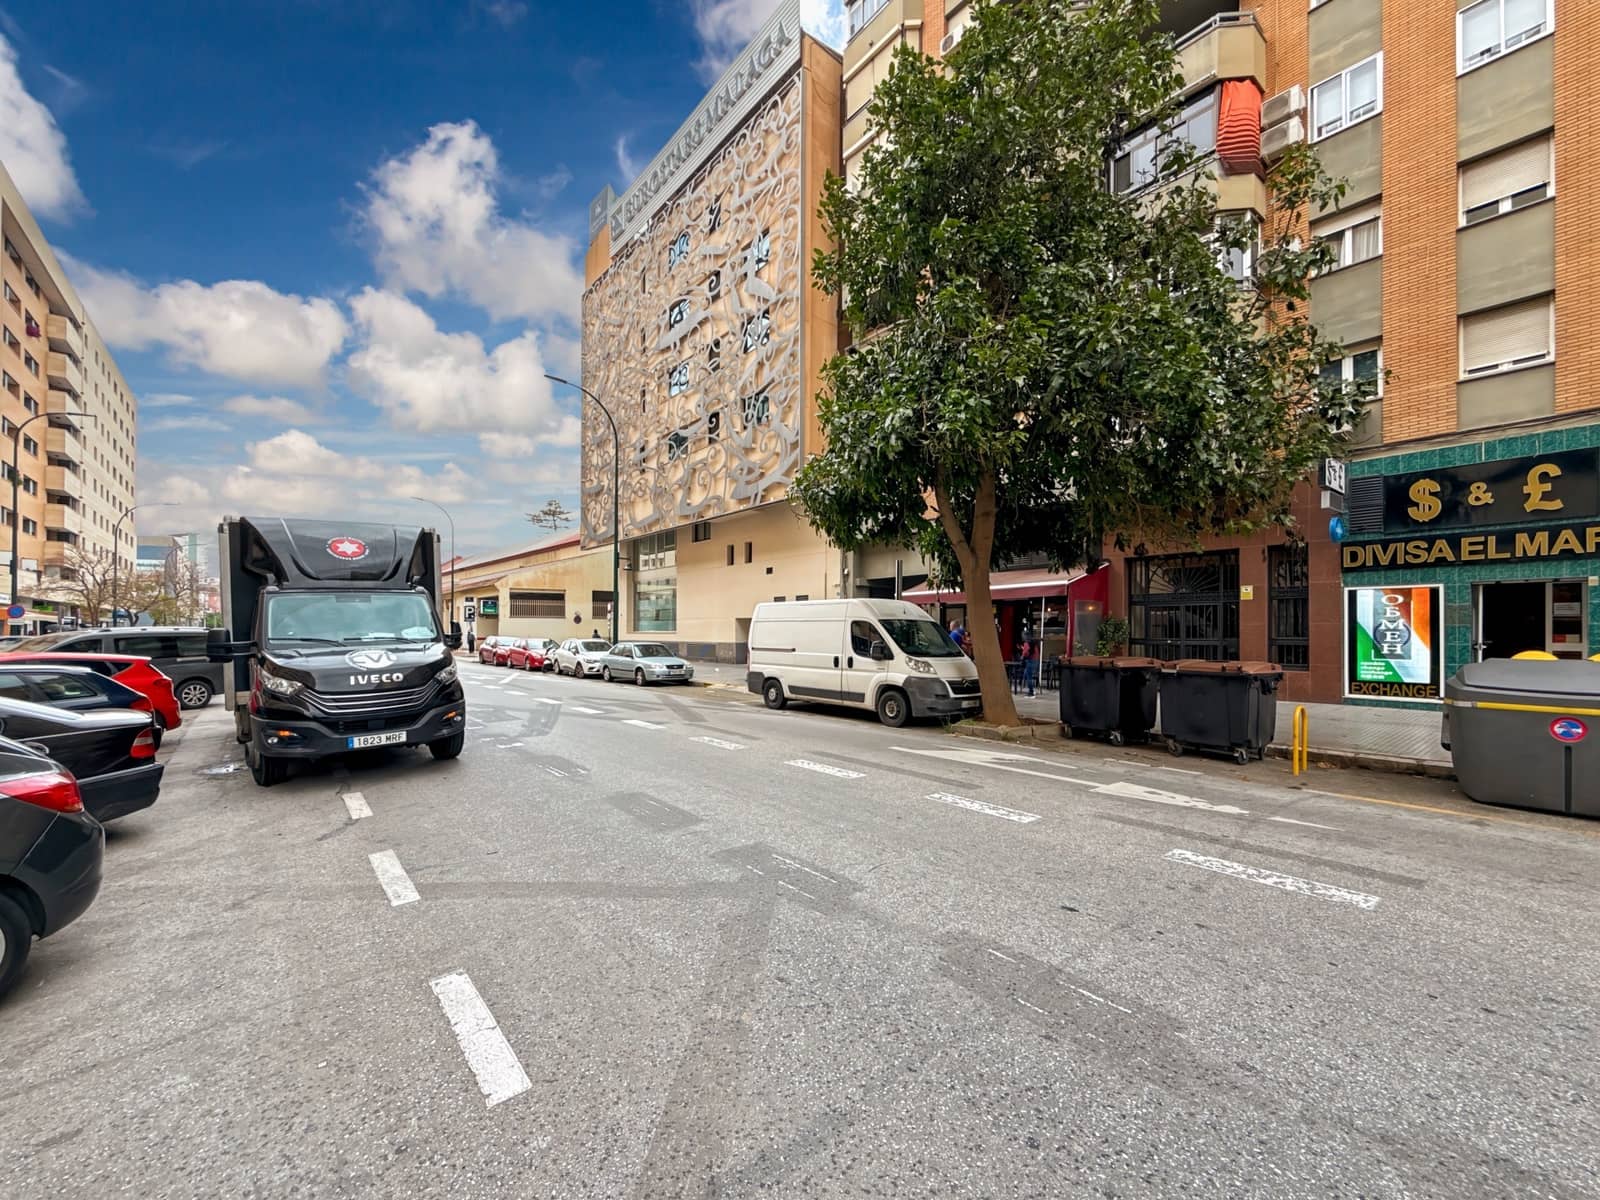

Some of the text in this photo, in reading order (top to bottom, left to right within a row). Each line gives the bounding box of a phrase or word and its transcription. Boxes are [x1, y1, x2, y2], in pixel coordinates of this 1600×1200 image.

[1407, 463, 1565, 522] $ & £
[1343, 539, 1456, 568] DIVISA
[1461, 535, 1511, 561] EL
[465, 606, 475, 618] P
[349, 672, 404, 686] IVECO
[1351, 682, 1437, 697] EXCHANGE
[357, 733, 404, 747] 1823 MRF
